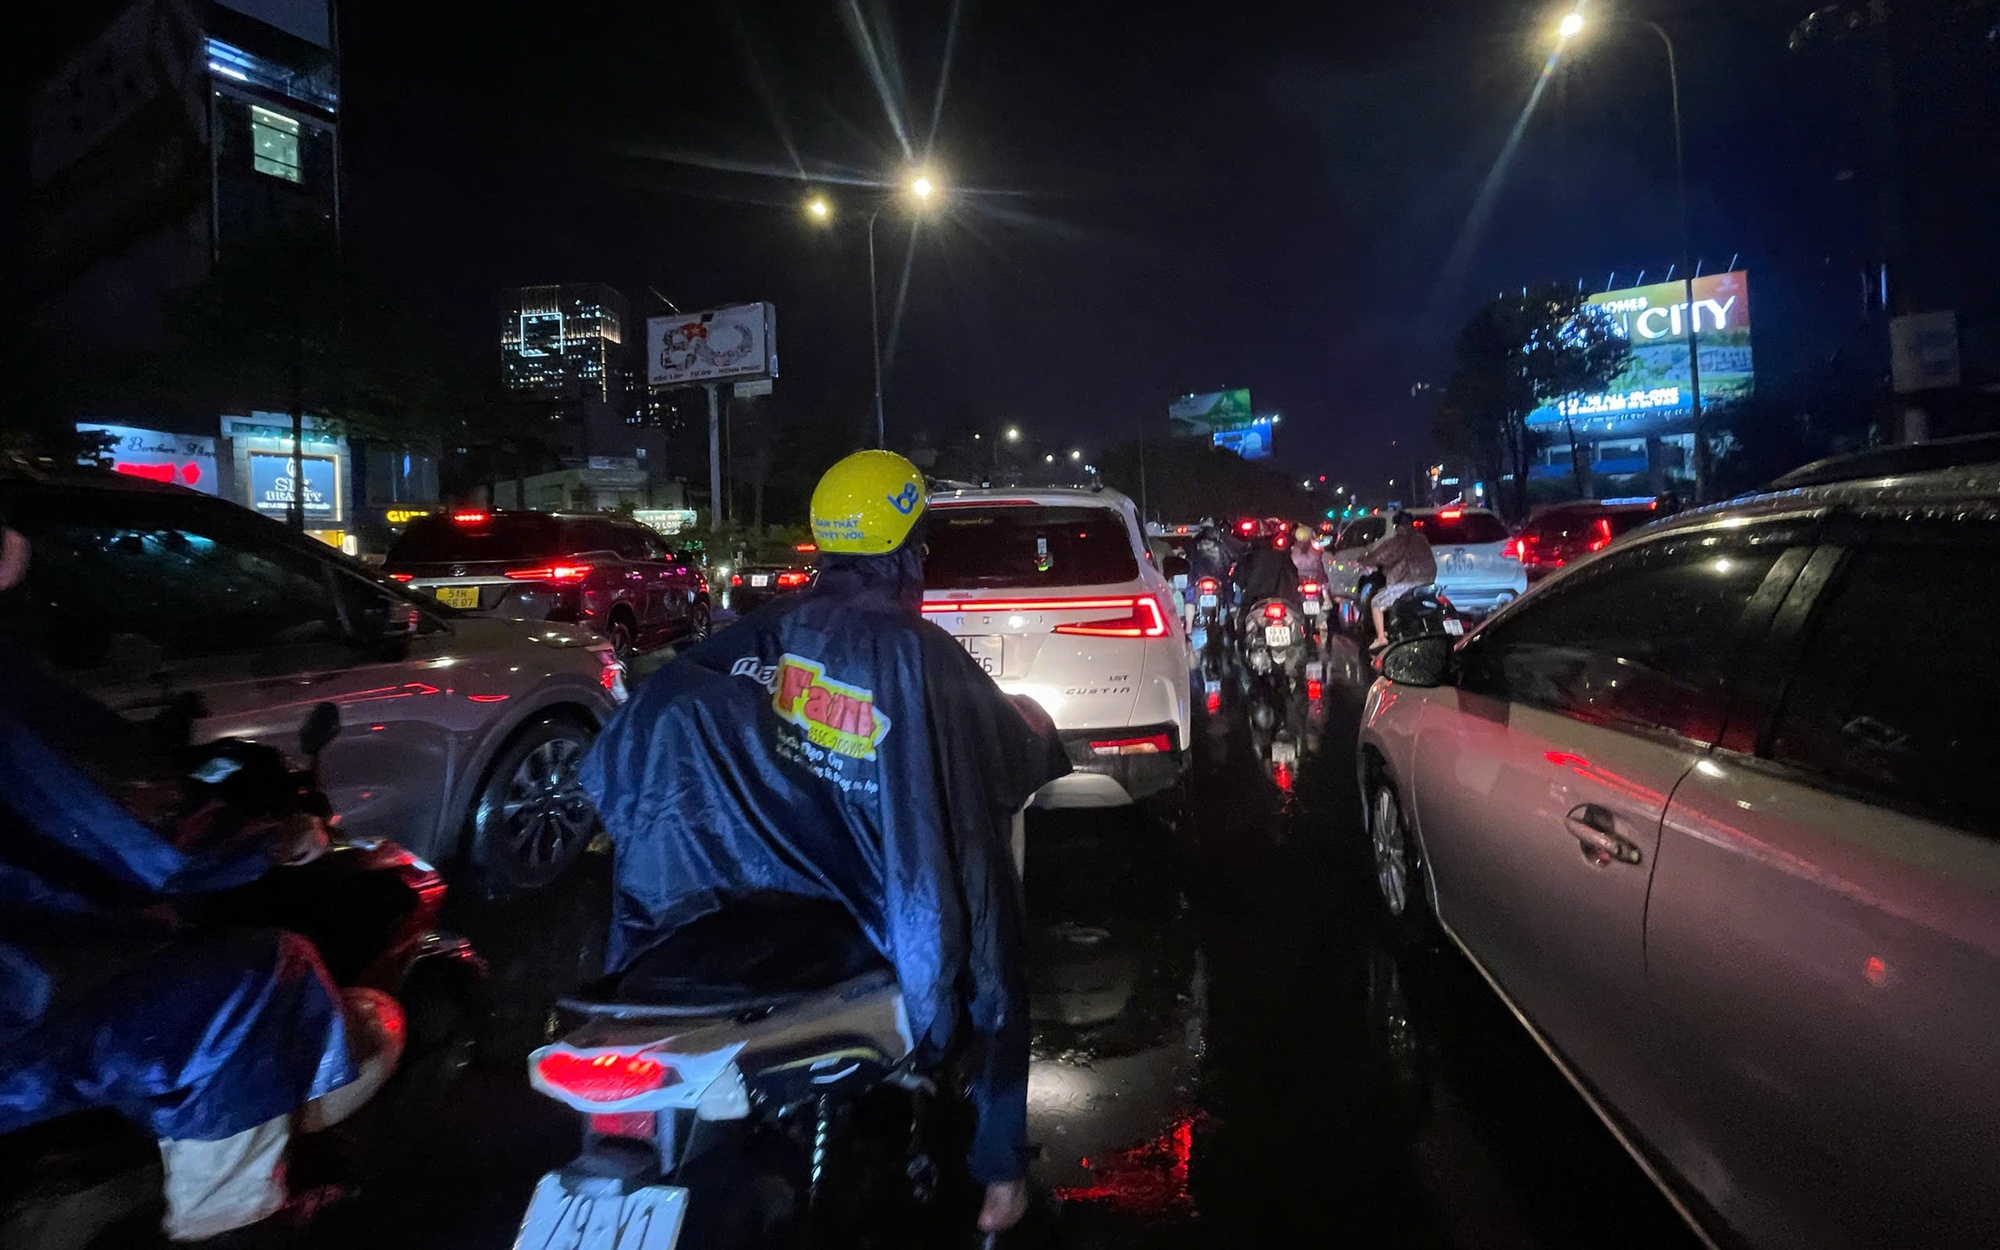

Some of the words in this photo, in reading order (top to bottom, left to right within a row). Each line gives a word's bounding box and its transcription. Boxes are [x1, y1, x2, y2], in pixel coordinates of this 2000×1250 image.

[1636, 295, 1736, 339] CITY
[266, 491, 322, 502] BEATY
[1065, 687, 1130, 695] CUSTIN
